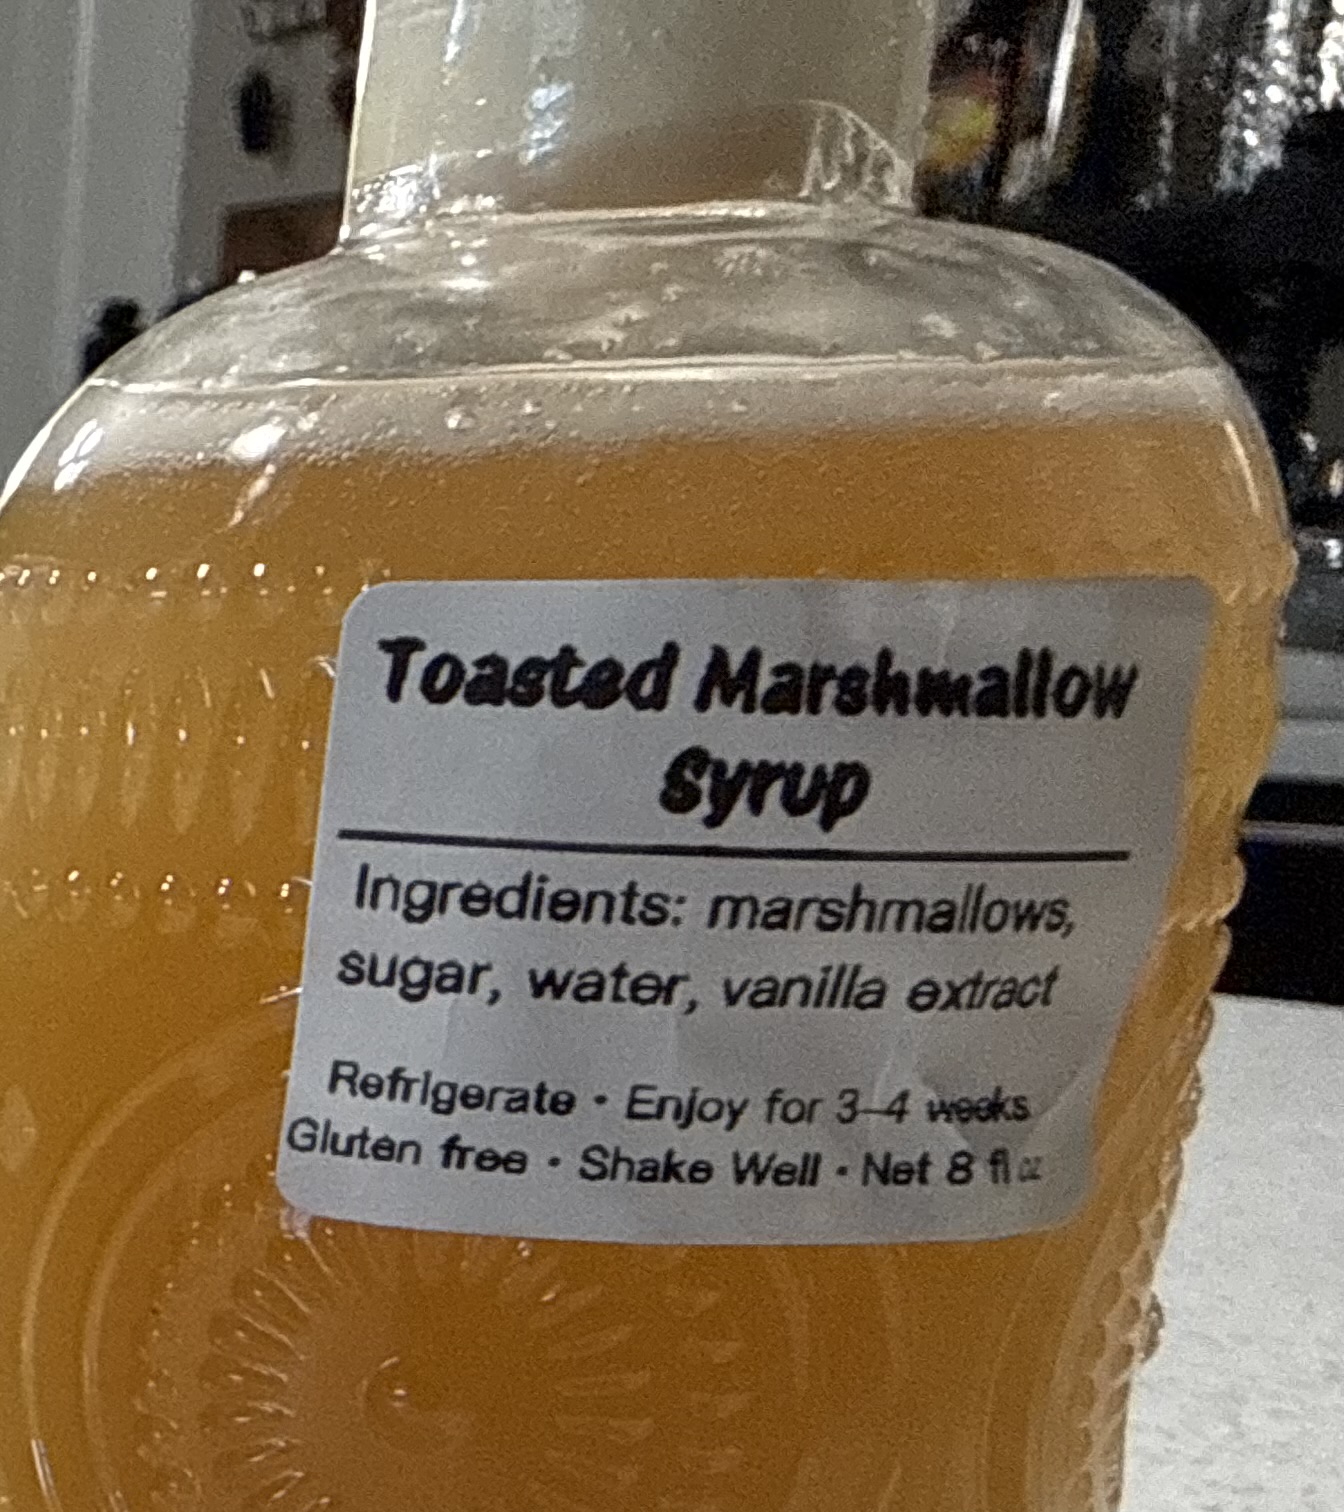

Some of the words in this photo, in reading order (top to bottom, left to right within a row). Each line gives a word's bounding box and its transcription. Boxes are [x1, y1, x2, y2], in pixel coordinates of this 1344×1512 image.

[378, 636, 681, 711] Toasted
[693, 645, 1139, 718] Marshmallow
[659, 745, 870, 832] Syrup
[356, 863, 685, 926] Ingredients:
[707, 882, 1074, 939] marshmallows,
[337, 949, 502, 1005] sugar,
[529, 962, 698, 1014] water,
[723, 963, 887, 1010] vanilla
[906, 964, 1060, 1012] extract
[328, 1059, 576, 1116] Refrigerate
[626, 1084, 749, 1130] Enjoy
[765, 1087, 823, 1124] for
[926, 1086, 1031, 1124] weeks
[286, 1116, 422, 1166] Gluten
[440, 1134, 528, 1175] free
[579, 1144, 713, 1186] Shake
[733, 1151, 822, 1187] Well
[863, 1151, 931, 1187] Net
[946, 1149, 974, 1186] 8
[988, 1147, 1010, 1185] fl
